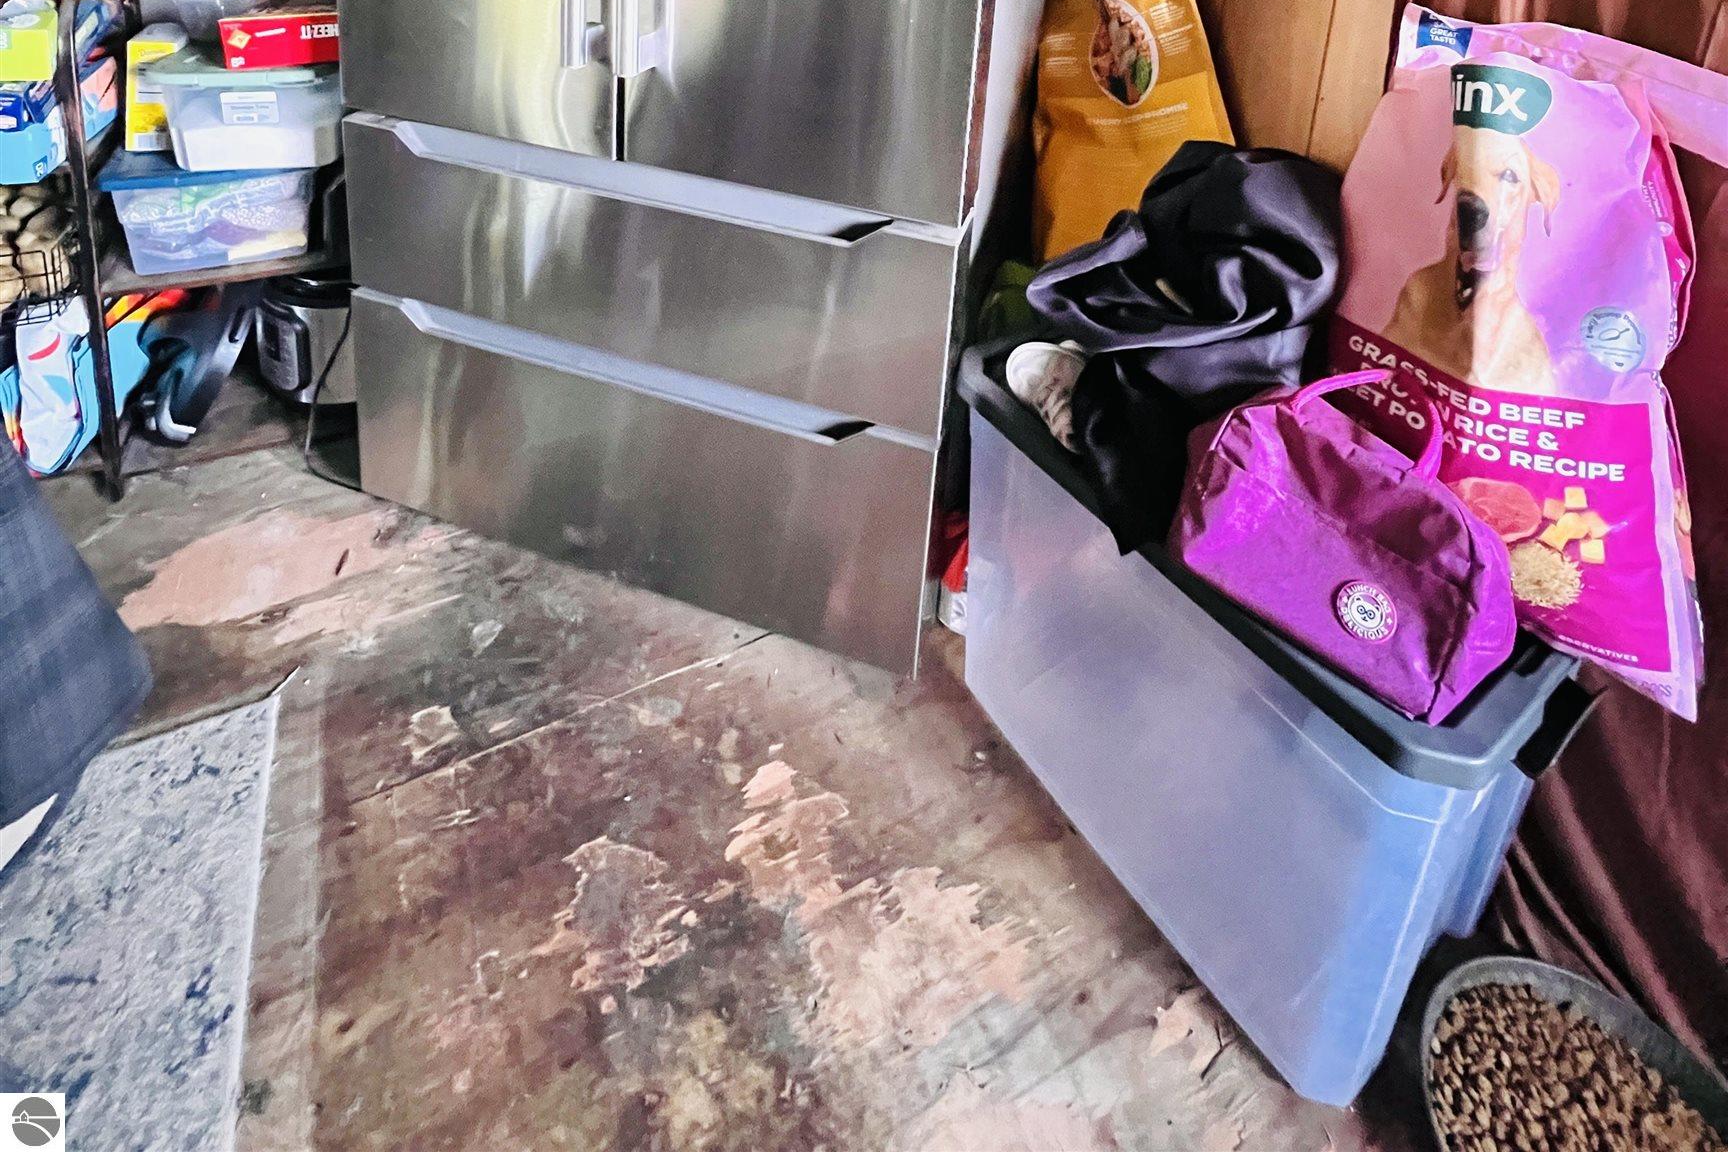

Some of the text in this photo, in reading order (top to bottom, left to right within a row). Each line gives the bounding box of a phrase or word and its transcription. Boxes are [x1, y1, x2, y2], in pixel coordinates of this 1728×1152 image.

[1453, 412, 1560, 451] RICE &
[1499, 402, 1586, 429] BEEF
[1509, 450, 1626, 482] RECIPE
